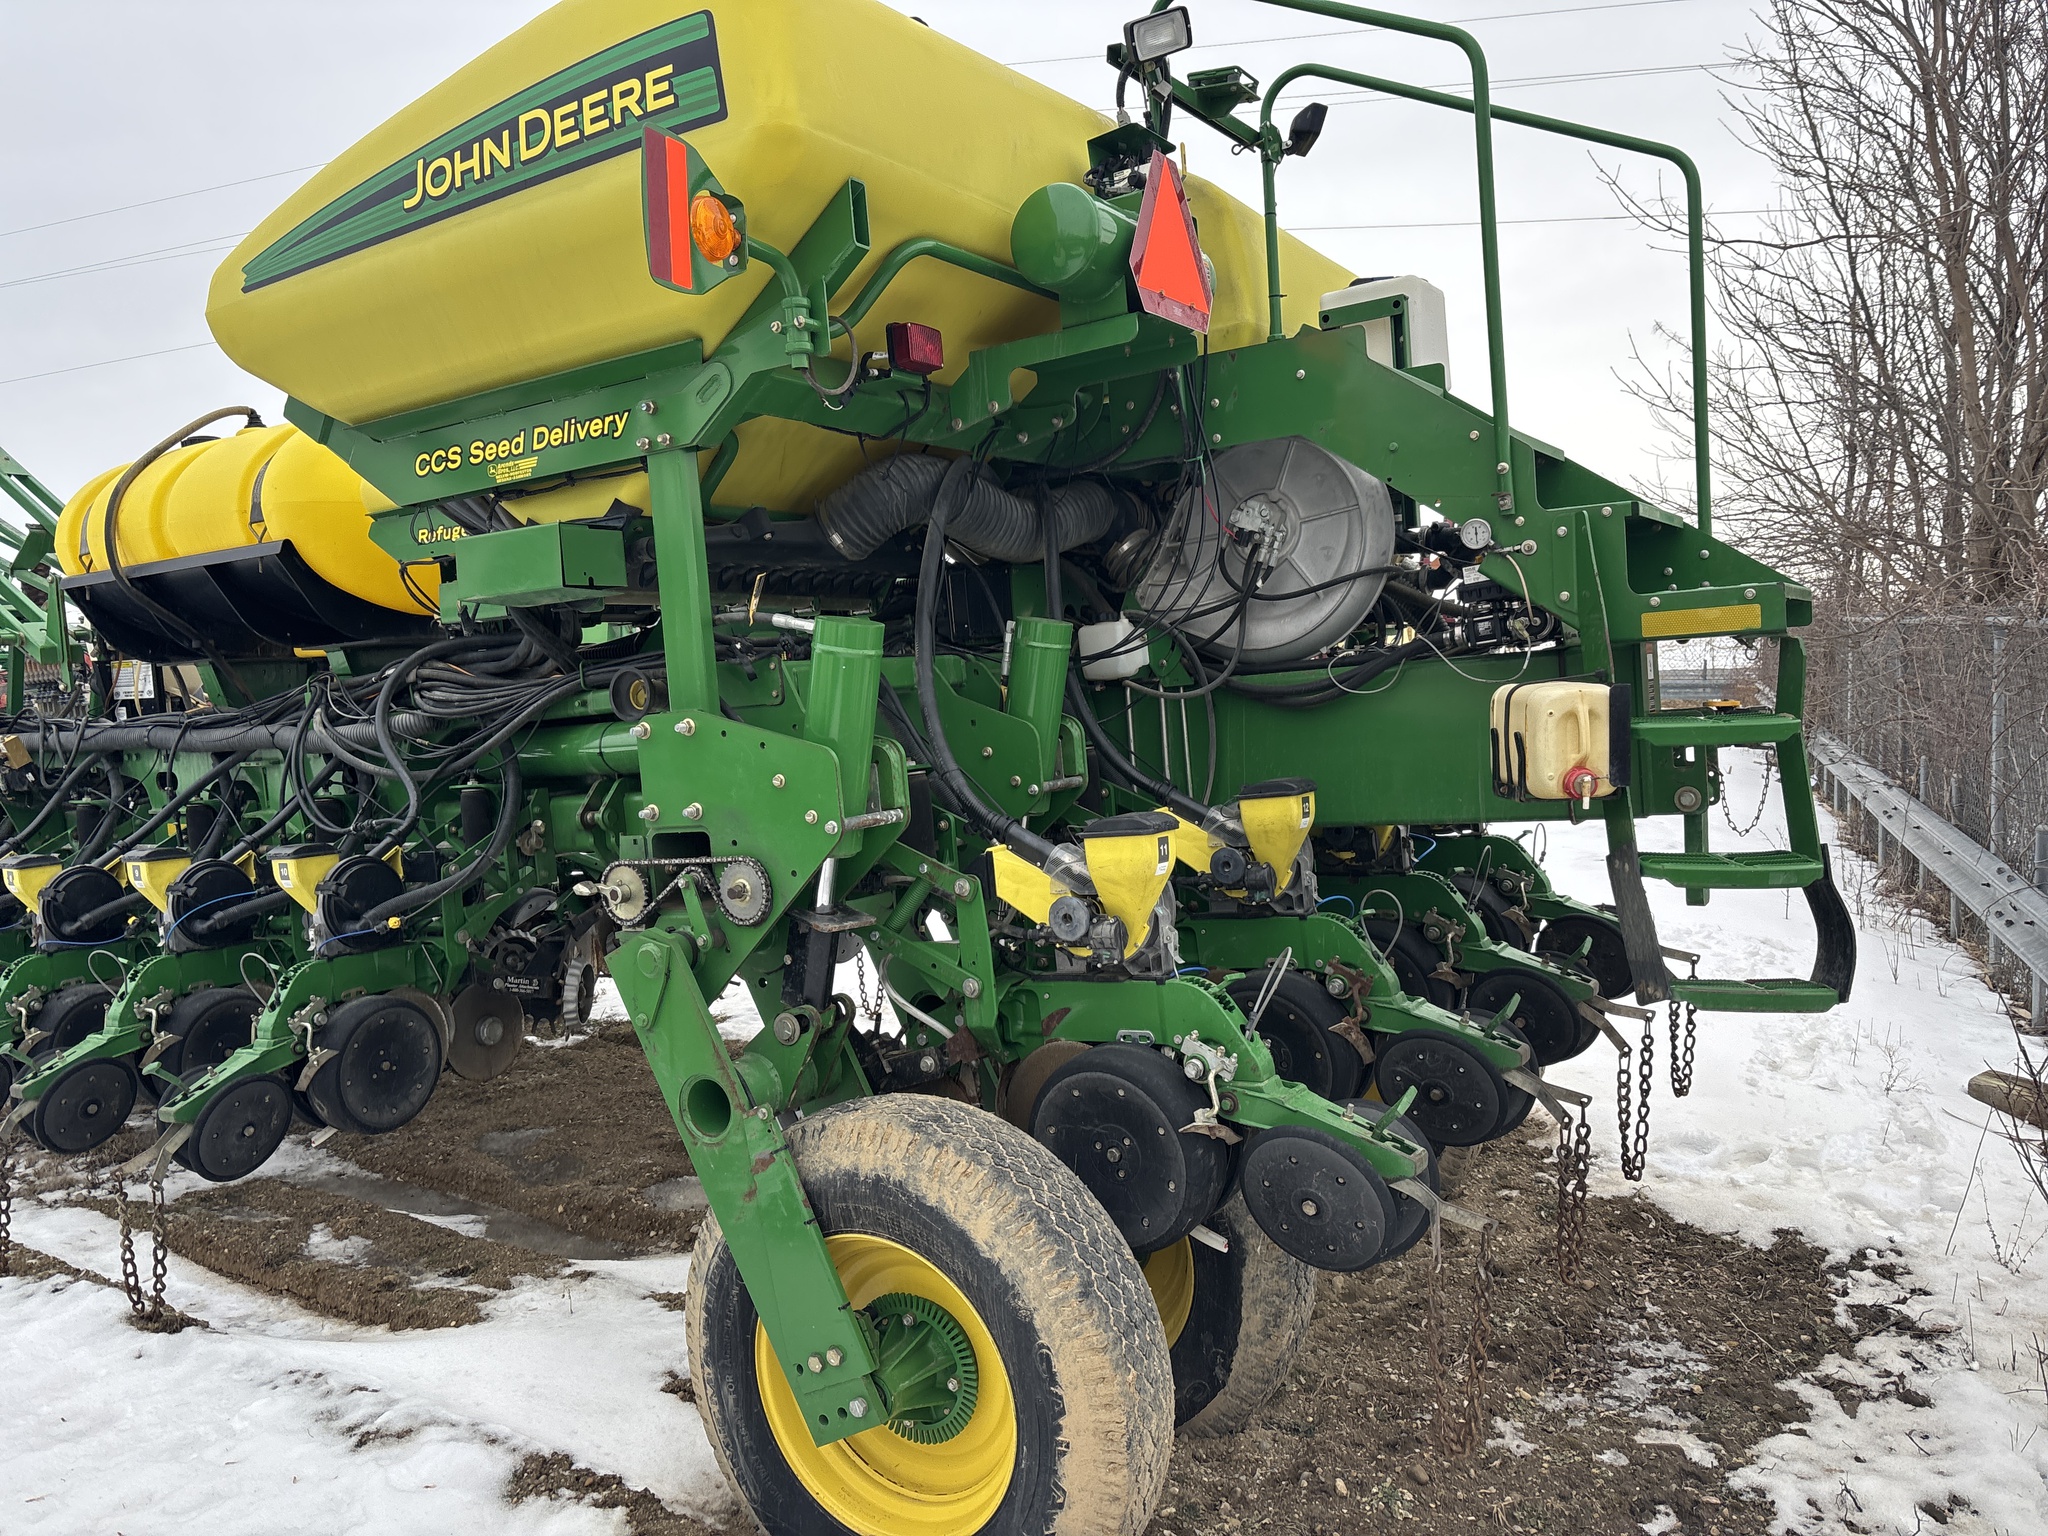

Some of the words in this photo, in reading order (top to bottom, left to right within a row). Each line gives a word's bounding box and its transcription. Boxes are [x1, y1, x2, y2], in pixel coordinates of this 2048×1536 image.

[403, 129, 512, 210] JOHN
[518, 63, 676, 162] DEERE
[415, 446, 462, 477] CCS
[469, 430, 525, 464] Seed
[533, 411, 630, 450] Delivery
[1160, 843, 1168, 856] 11
[280, 867, 288, 876] 10
[507, 976, 529, 985] Martin
[726, 1375, 736, 1399] FOR
